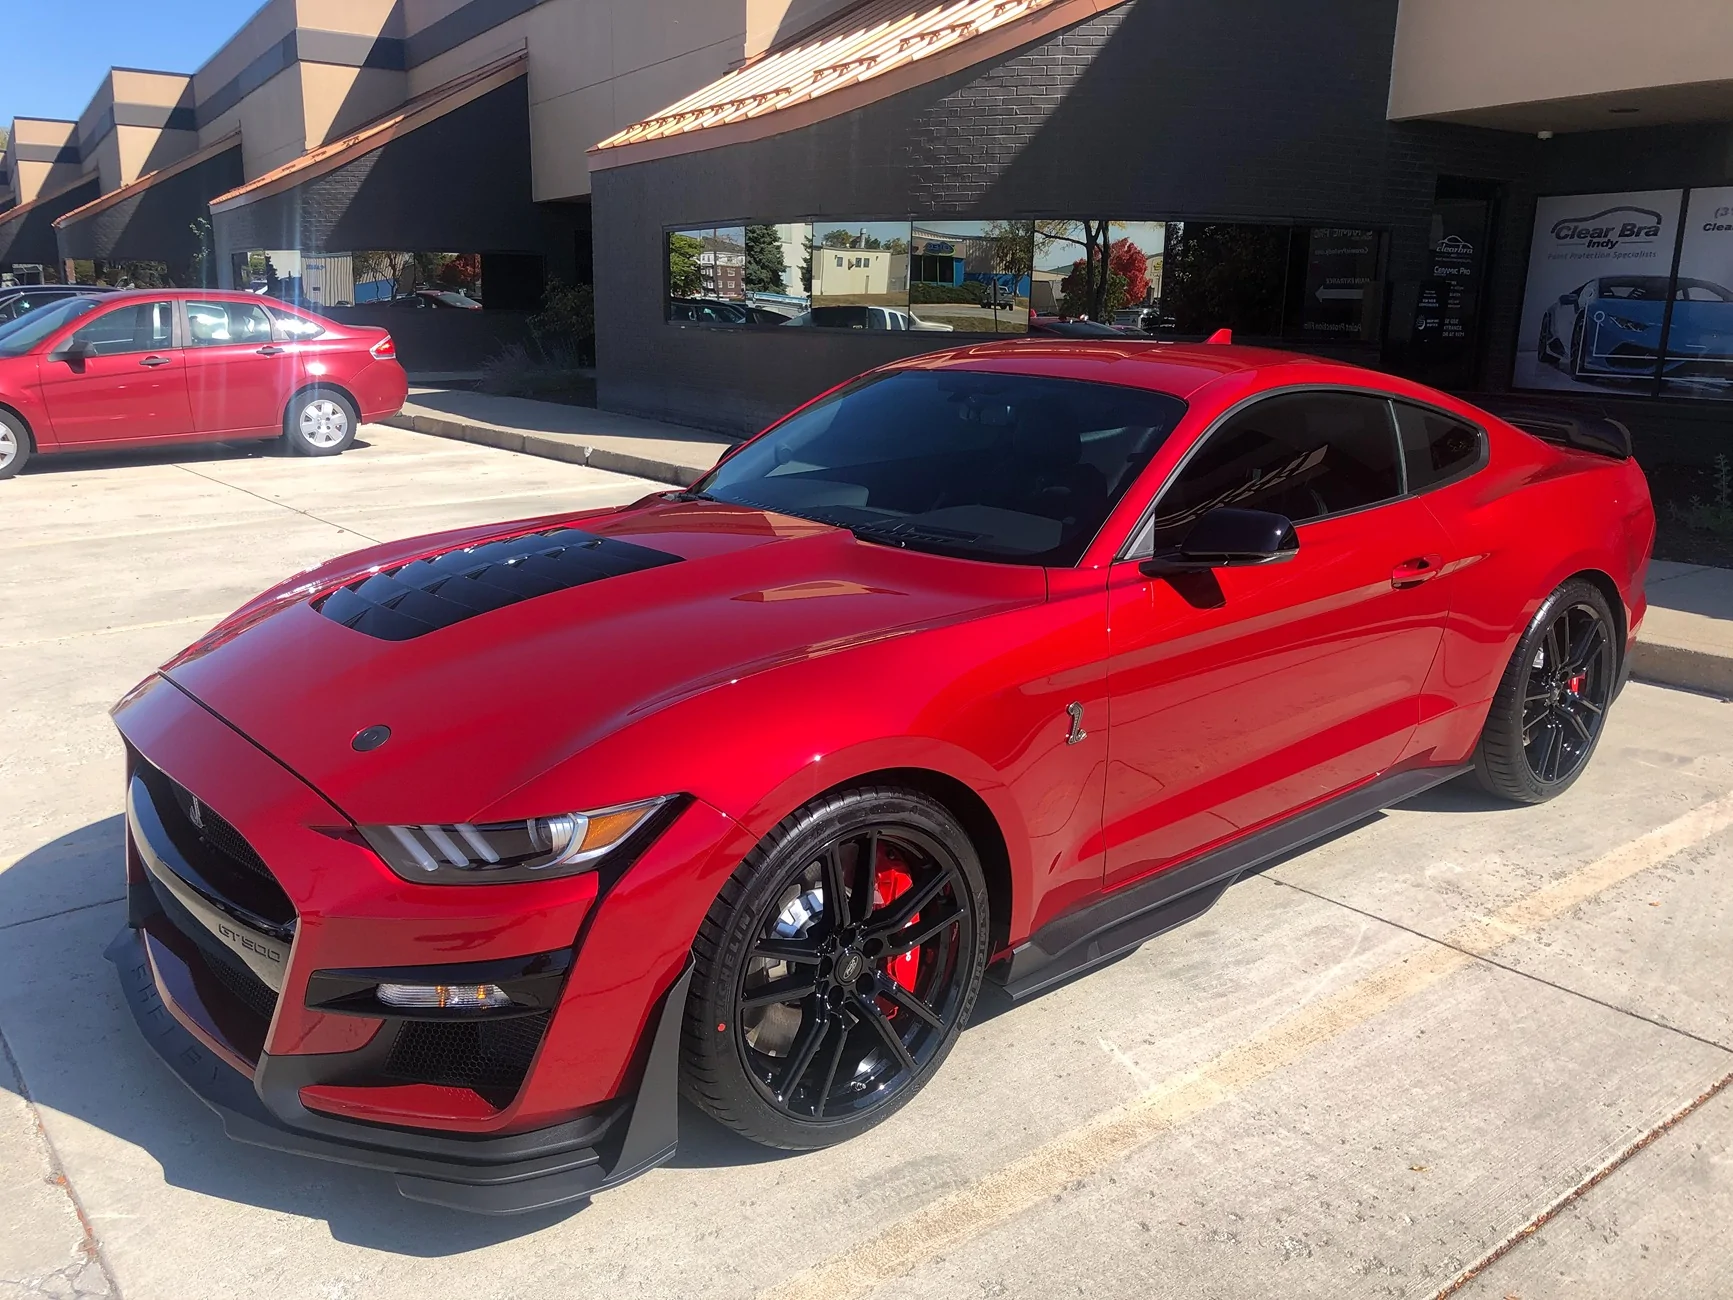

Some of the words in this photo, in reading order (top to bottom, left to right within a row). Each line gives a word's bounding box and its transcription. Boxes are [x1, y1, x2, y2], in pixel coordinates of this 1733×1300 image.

[1555, 224, 1615, 240] Clear
[1618, 222, 1660, 238] Bra
[1703, 222, 1733, 232] Clea
[1587, 239, 1619, 249] Indy
[1569, 251, 1611, 260] Protection
[1612, 250, 1657, 260] Specialists
[218, 923, 281, 964] GT500
